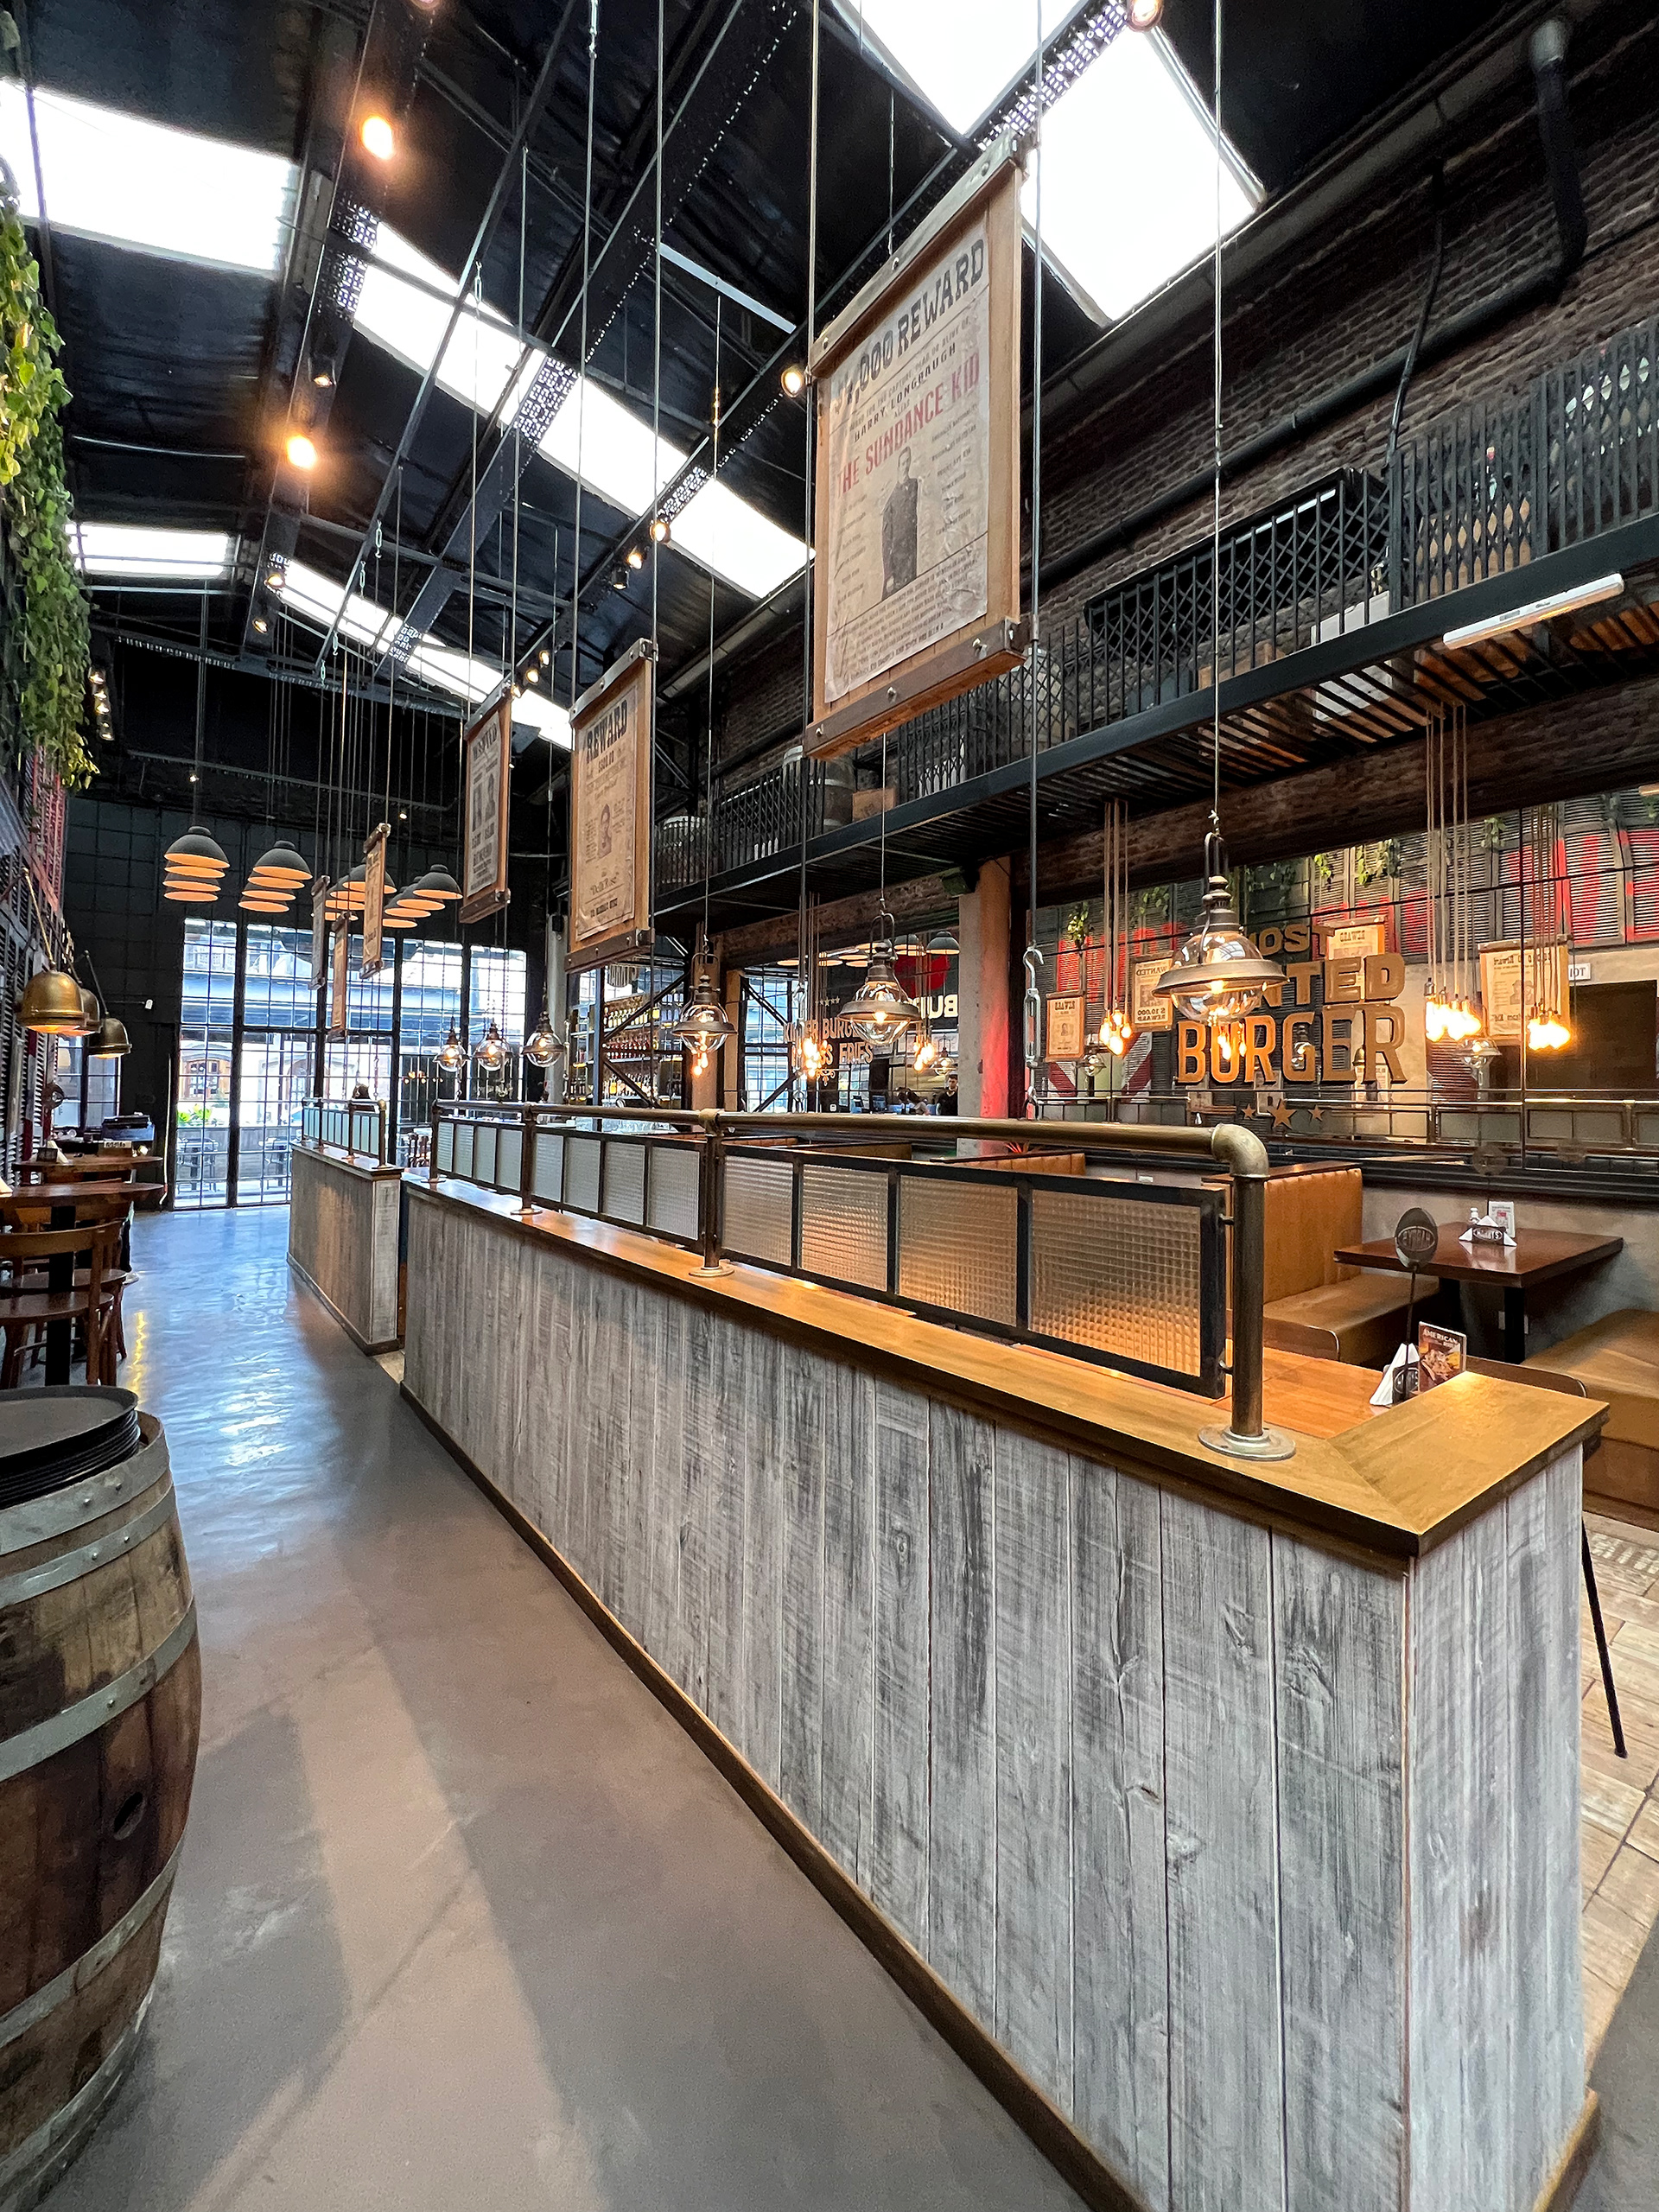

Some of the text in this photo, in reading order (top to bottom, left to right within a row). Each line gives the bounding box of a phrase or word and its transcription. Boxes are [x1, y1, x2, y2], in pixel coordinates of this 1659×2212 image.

[898, 239, 983, 356] REWARD
[837, 455, 861, 497] THE
[865, 382, 944, 476] SUNDANCE
[951, 351, 980, 403] KID
[855, 405, 886, 443] HARRY
[587, 700, 628, 765] REWARD
[1249, 925, 1337, 957] OST
[1178, 1006, 1408, 1084] BURGER
